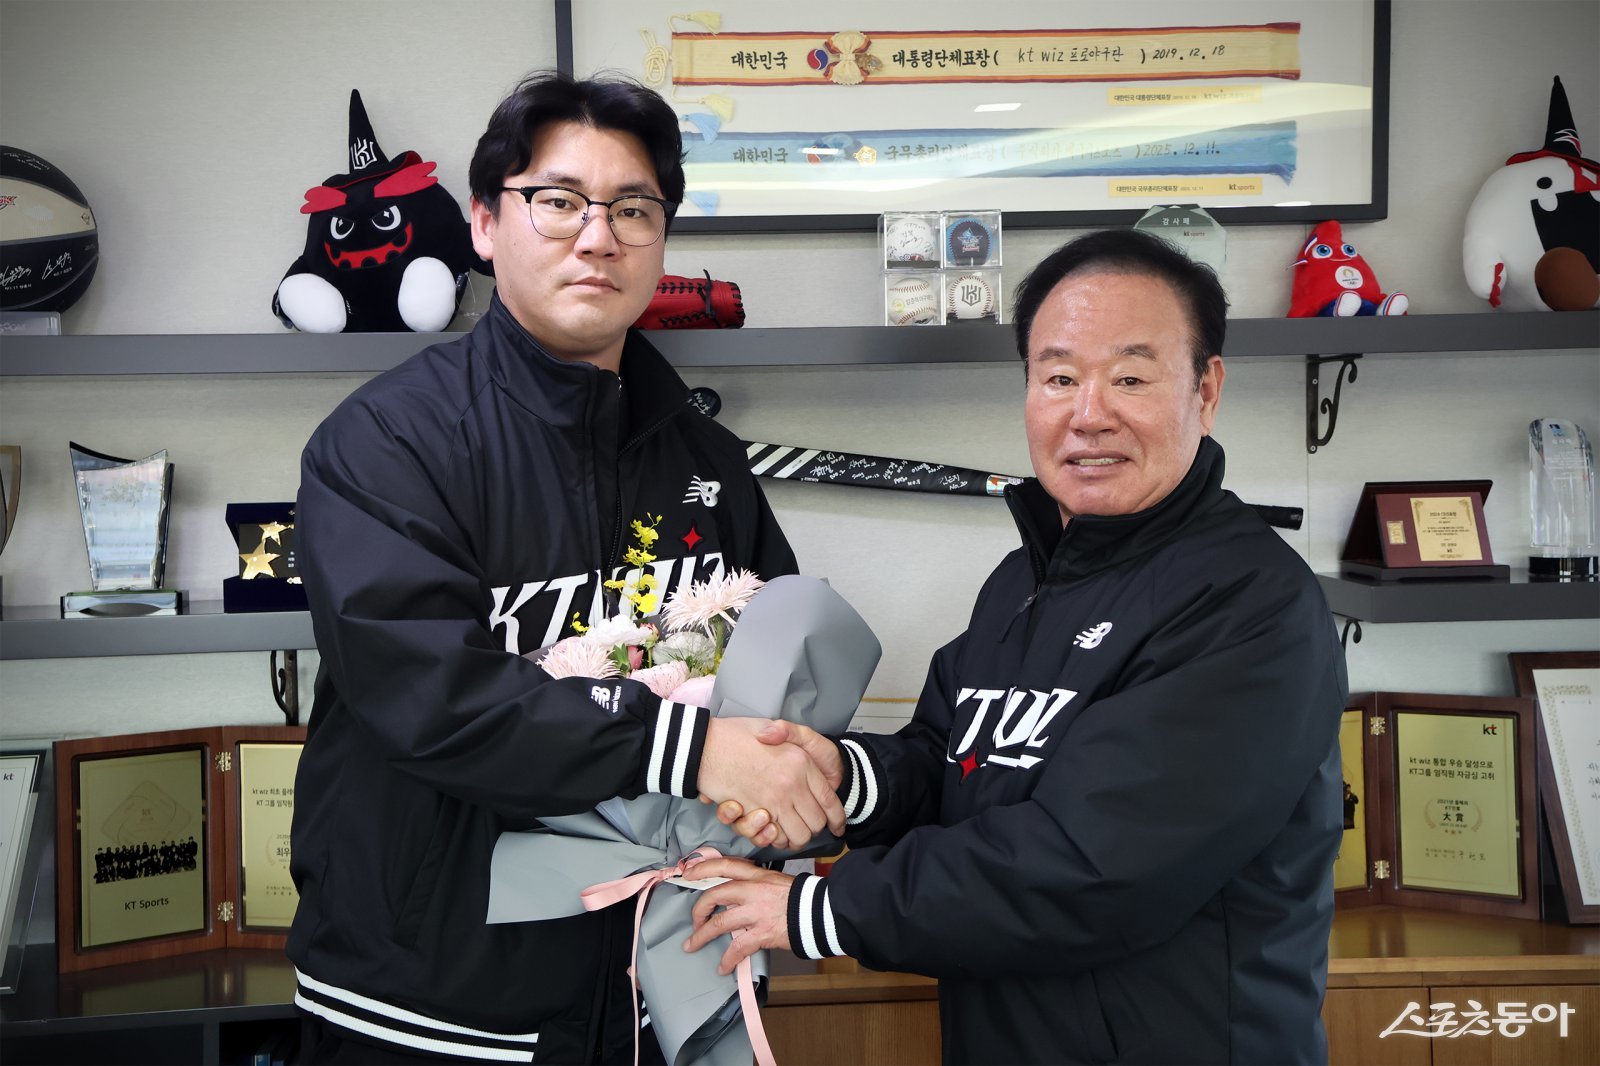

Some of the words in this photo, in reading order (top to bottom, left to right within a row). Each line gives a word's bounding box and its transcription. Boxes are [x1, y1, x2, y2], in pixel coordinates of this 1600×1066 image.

[731, 50, 788, 70] 대한민국
[1018, 47, 1034, 63] kt
[1041, 47, 1064, 62] wiz
[1069, 46, 1124, 63] 프로야구단
[733, 146, 788, 164] 대한민국
[1483, 723, 1497, 736] kt
[1409, 757, 1417, 765] kt
[1418, 757, 1431, 765] wiz
[1433, 758, 1446, 767] 통합
[1449, 758, 1463, 768] 우승
[1465, 759, 1494, 769] 달성으로
[3, 772, 14, 781] kt
[1409, 768, 1431, 777] KT그룹
[1434, 769, 1455, 779] 임직원
[124, 900, 137, 911] KT
[139, 897, 169, 909] Sports
